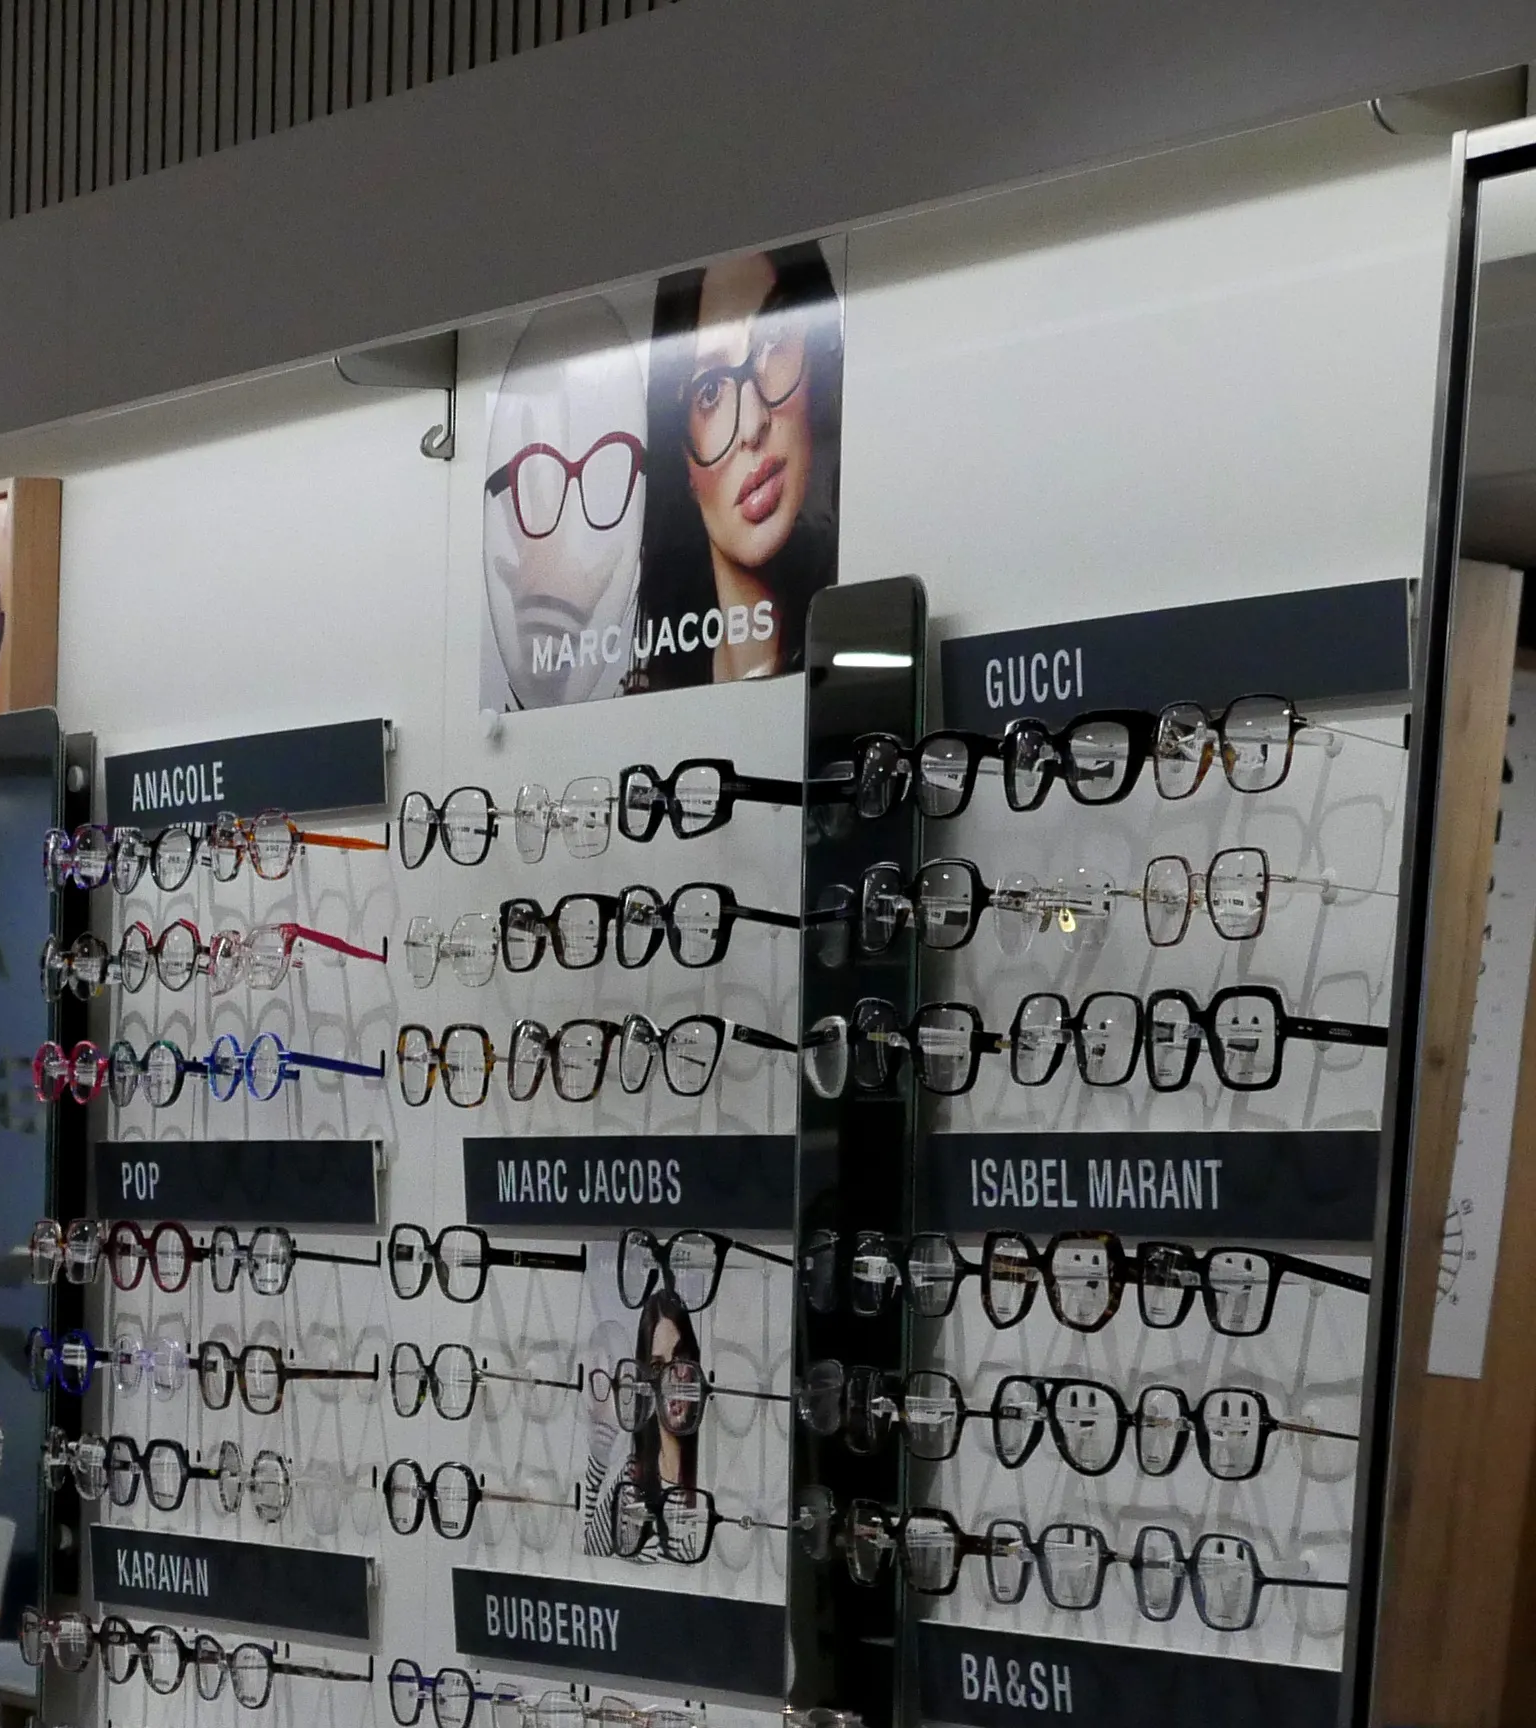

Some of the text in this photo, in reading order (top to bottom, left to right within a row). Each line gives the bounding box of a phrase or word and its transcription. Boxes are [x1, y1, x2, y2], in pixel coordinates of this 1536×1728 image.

[532, 601, 774, 674] MARC JACOBS
[985, 647, 1083, 709] GUCCI
[132, 761, 225, 812] ANACOLE
[122, 1161, 160, 1201] POP
[497, 1159, 683, 1205] MARC JACOBS
[970, 1158, 1223, 1210] ISABEL MARANT
[117, 1548, 210, 1598] KARAVAN
[486, 1593, 621, 1652] BURBERRY
[961, 1652, 1073, 1714] BA&SH
